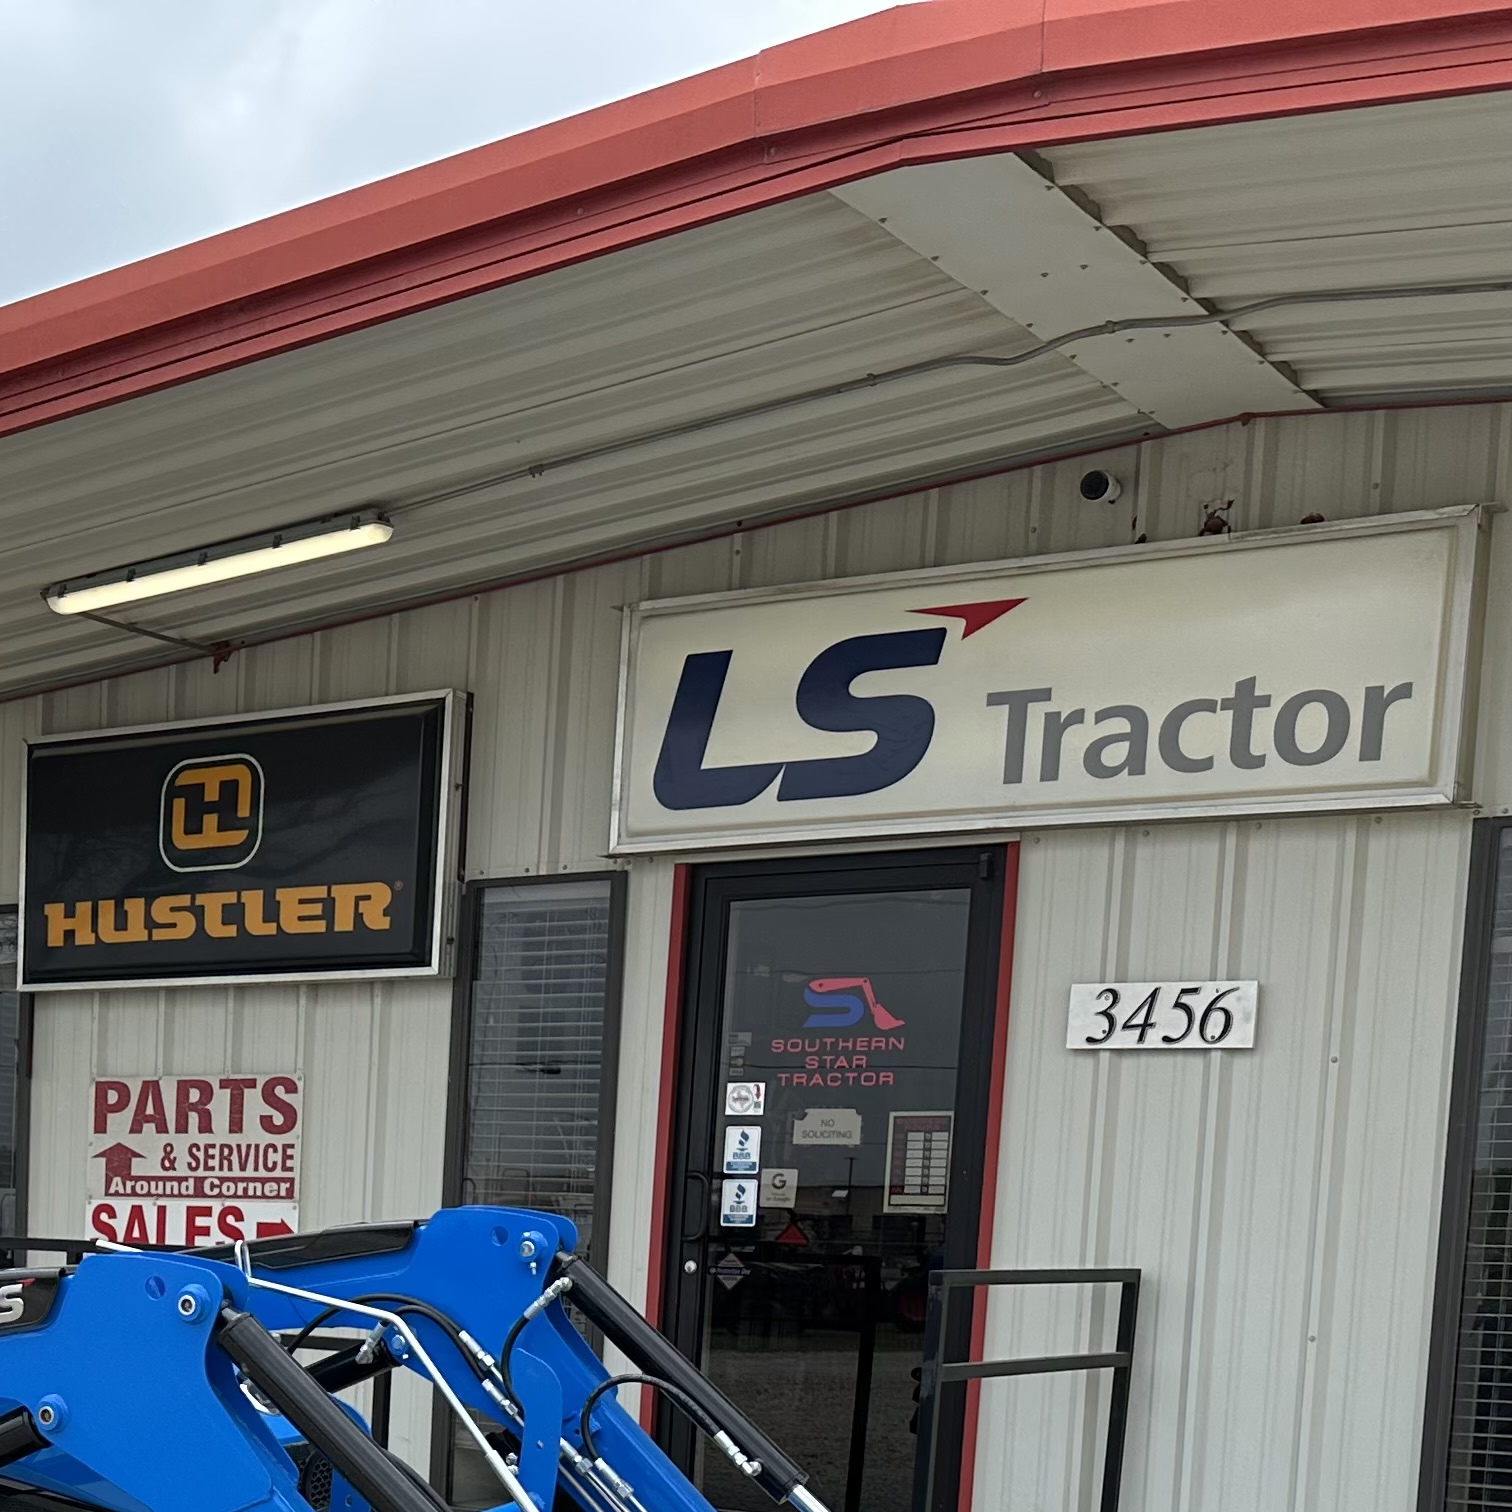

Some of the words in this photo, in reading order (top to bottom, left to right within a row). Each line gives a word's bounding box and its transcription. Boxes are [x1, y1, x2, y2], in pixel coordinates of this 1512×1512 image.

[653, 627, 948, 811] LS
[986, 675, 1414, 786] Tractor
[44, 881, 393, 947] HUSTLER
[1085, 986, 1240, 1045] 3456
[771, 1037, 905, 1053] SOUTHERN
[805, 1055, 867, 1069] STAR
[777, 1071, 894, 1087] TRACTOR
[93, 1076, 299, 1135] PARTS
[801, 1130, 853, 1140] SOLICITING
[820, 1118, 835, 1128] NO
[160, 1143, 177, 1172] &
[187, 1143, 296, 1173] SERVICE
[108, 1176, 194, 1196] Around
[203, 1177, 291, 1197] Corner
[91, 1203, 245, 1248] SALES
